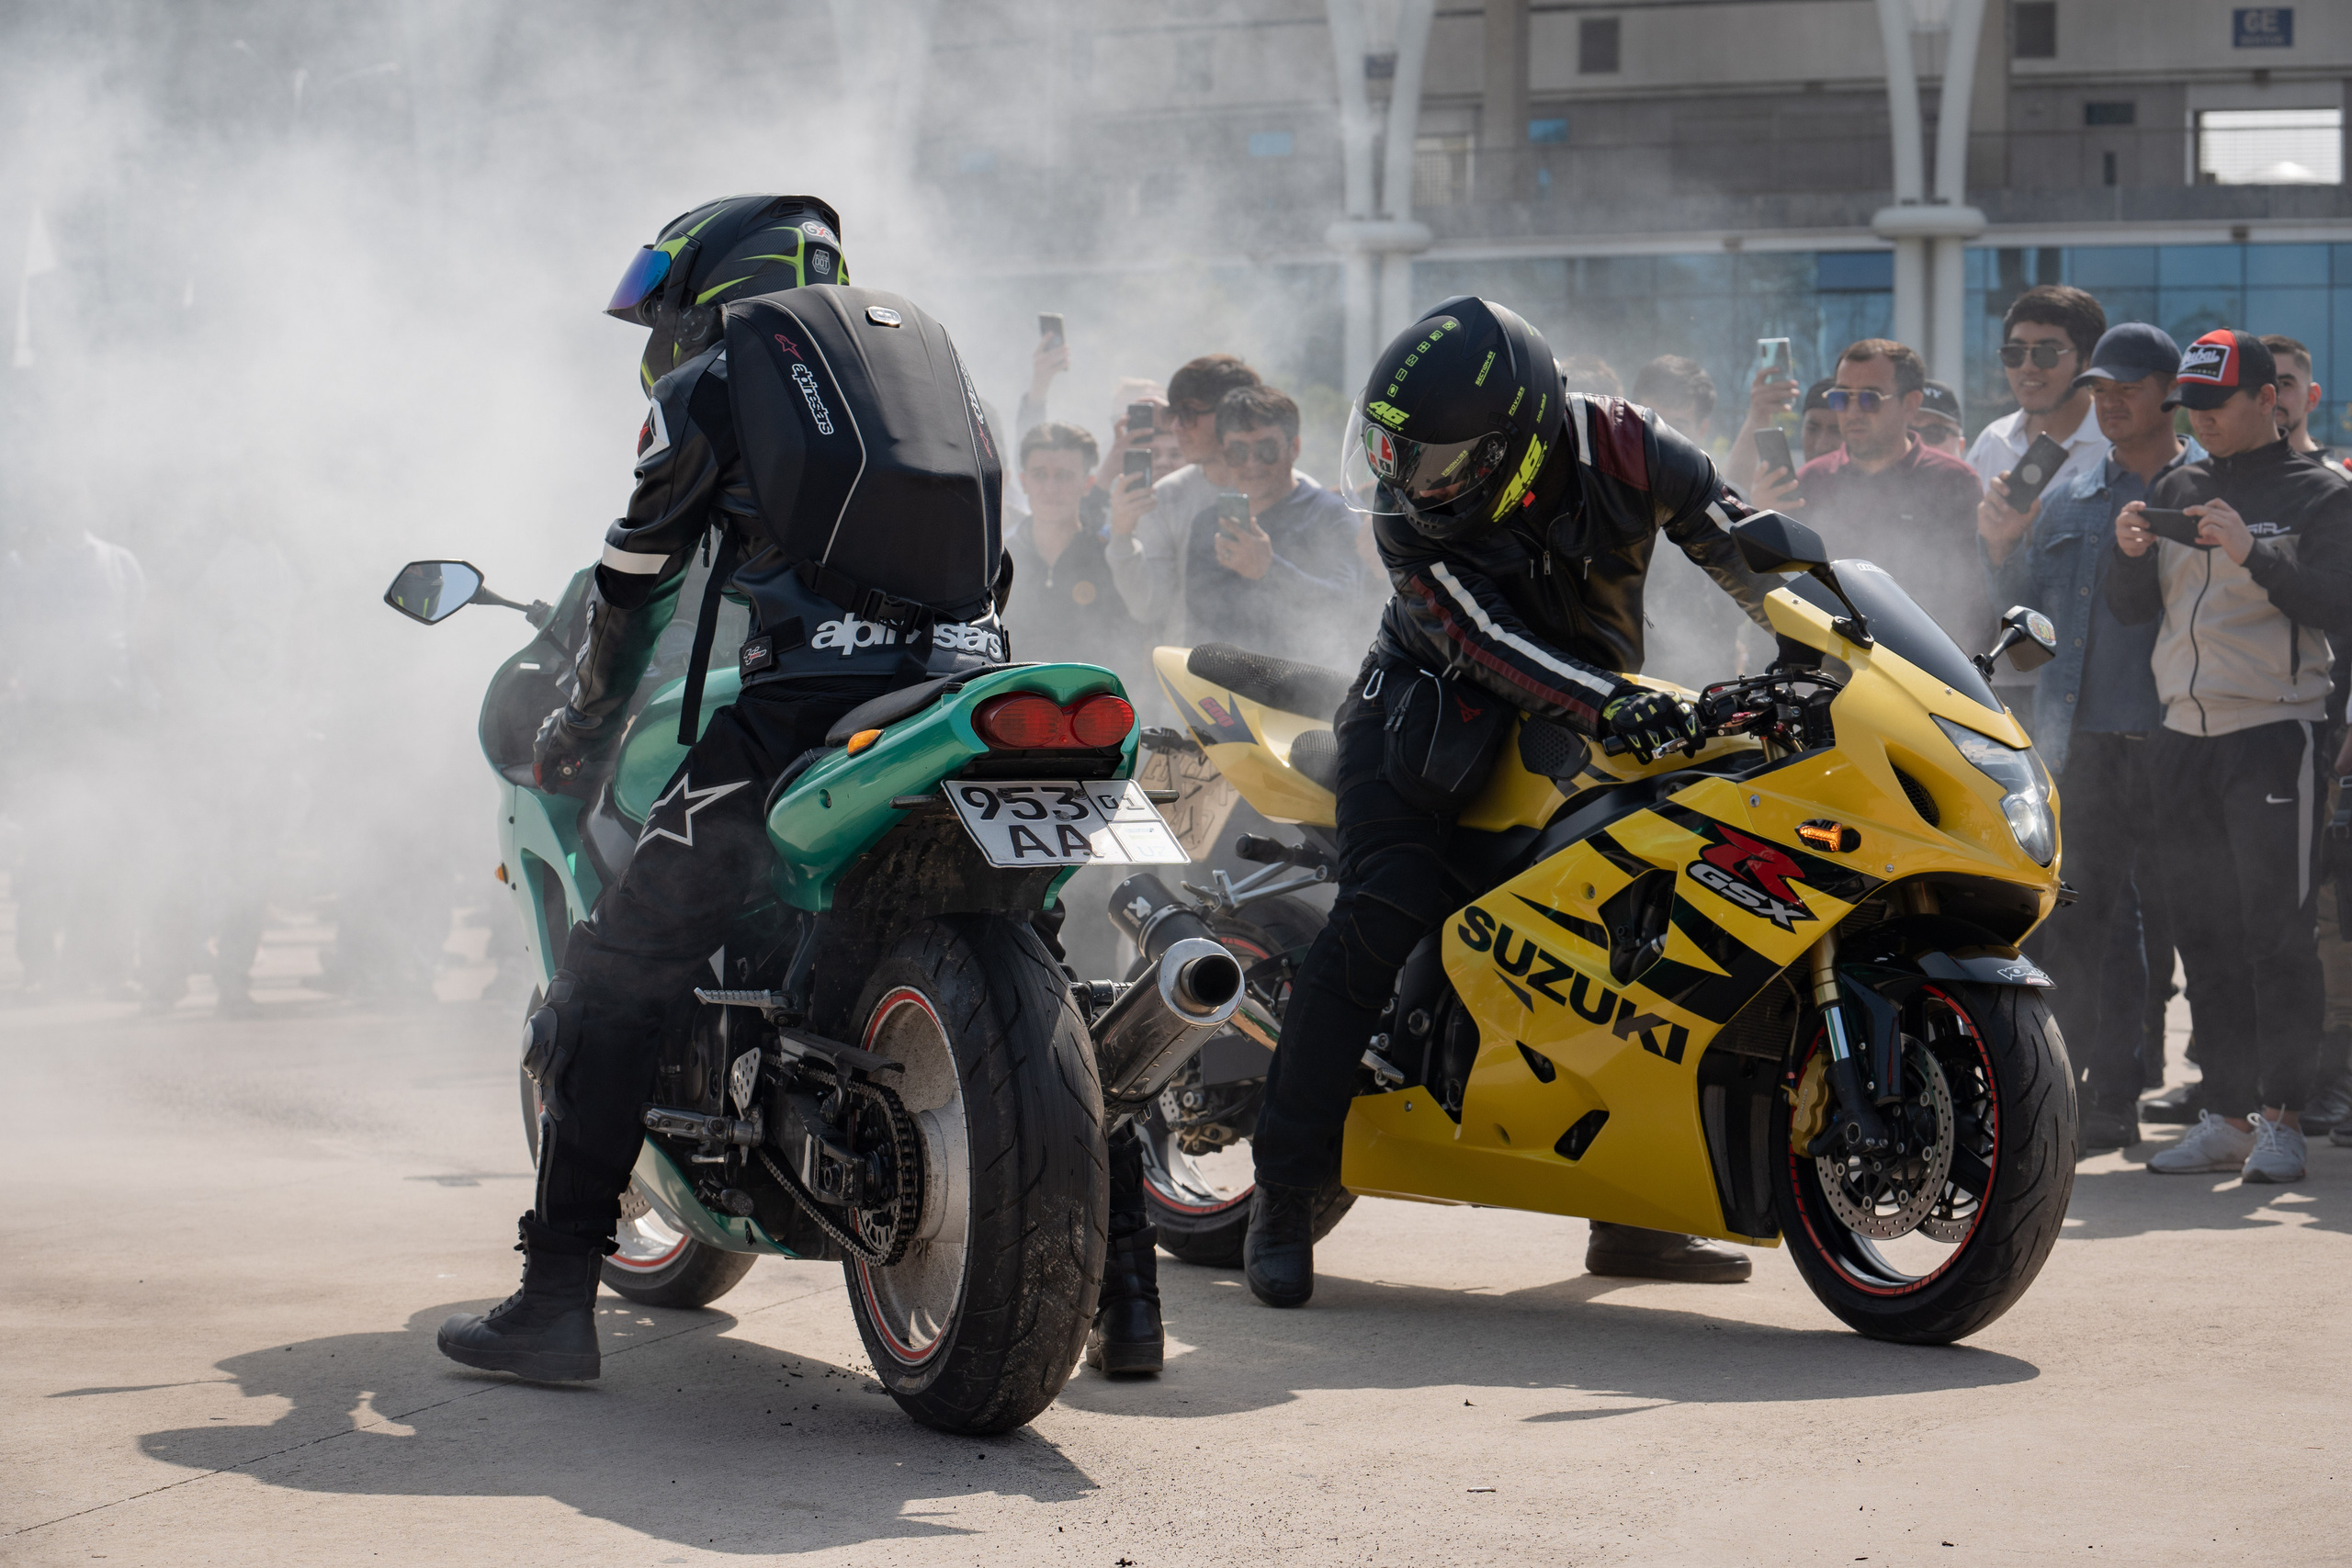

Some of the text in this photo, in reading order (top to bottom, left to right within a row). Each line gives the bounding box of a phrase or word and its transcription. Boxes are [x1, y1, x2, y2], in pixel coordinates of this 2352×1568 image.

[791, 363, 834, 435] alpinestars
[1368, 400, 1410, 425] 46
[1366, 407, 1404, 432] PROJECT
[811, 612, 1002, 659] alpinstars
[1199, 697, 1235, 728] 600
[960, 786, 1090, 820] 953
[1007, 824, 1105, 859] AA
[1690, 863, 1808, 927] GSX
[1457, 905, 1690, 1066] SUZUKI
